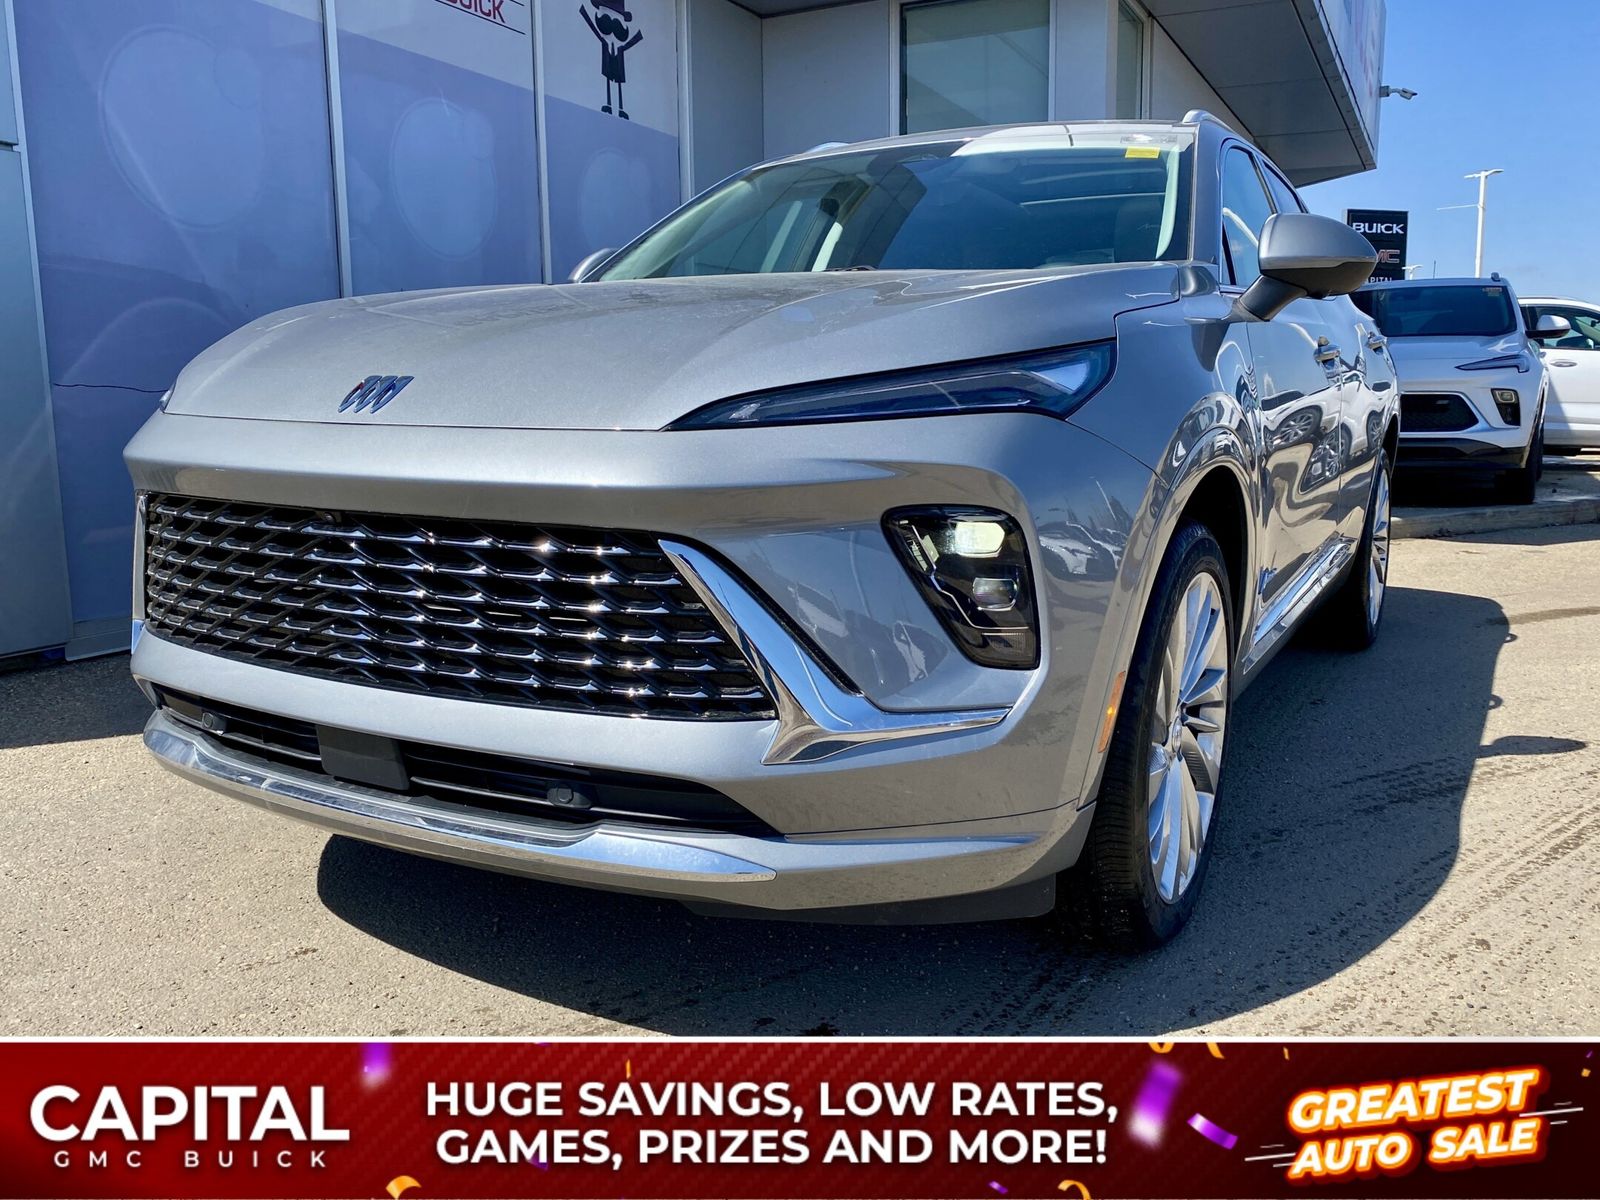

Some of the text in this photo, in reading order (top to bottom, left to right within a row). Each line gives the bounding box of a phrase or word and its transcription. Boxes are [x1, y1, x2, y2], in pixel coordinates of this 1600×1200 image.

[447, 0, 505, 23] ICK
[1353, 222, 1404, 234] BUICK
[1376, 249, 1400, 264] MC
